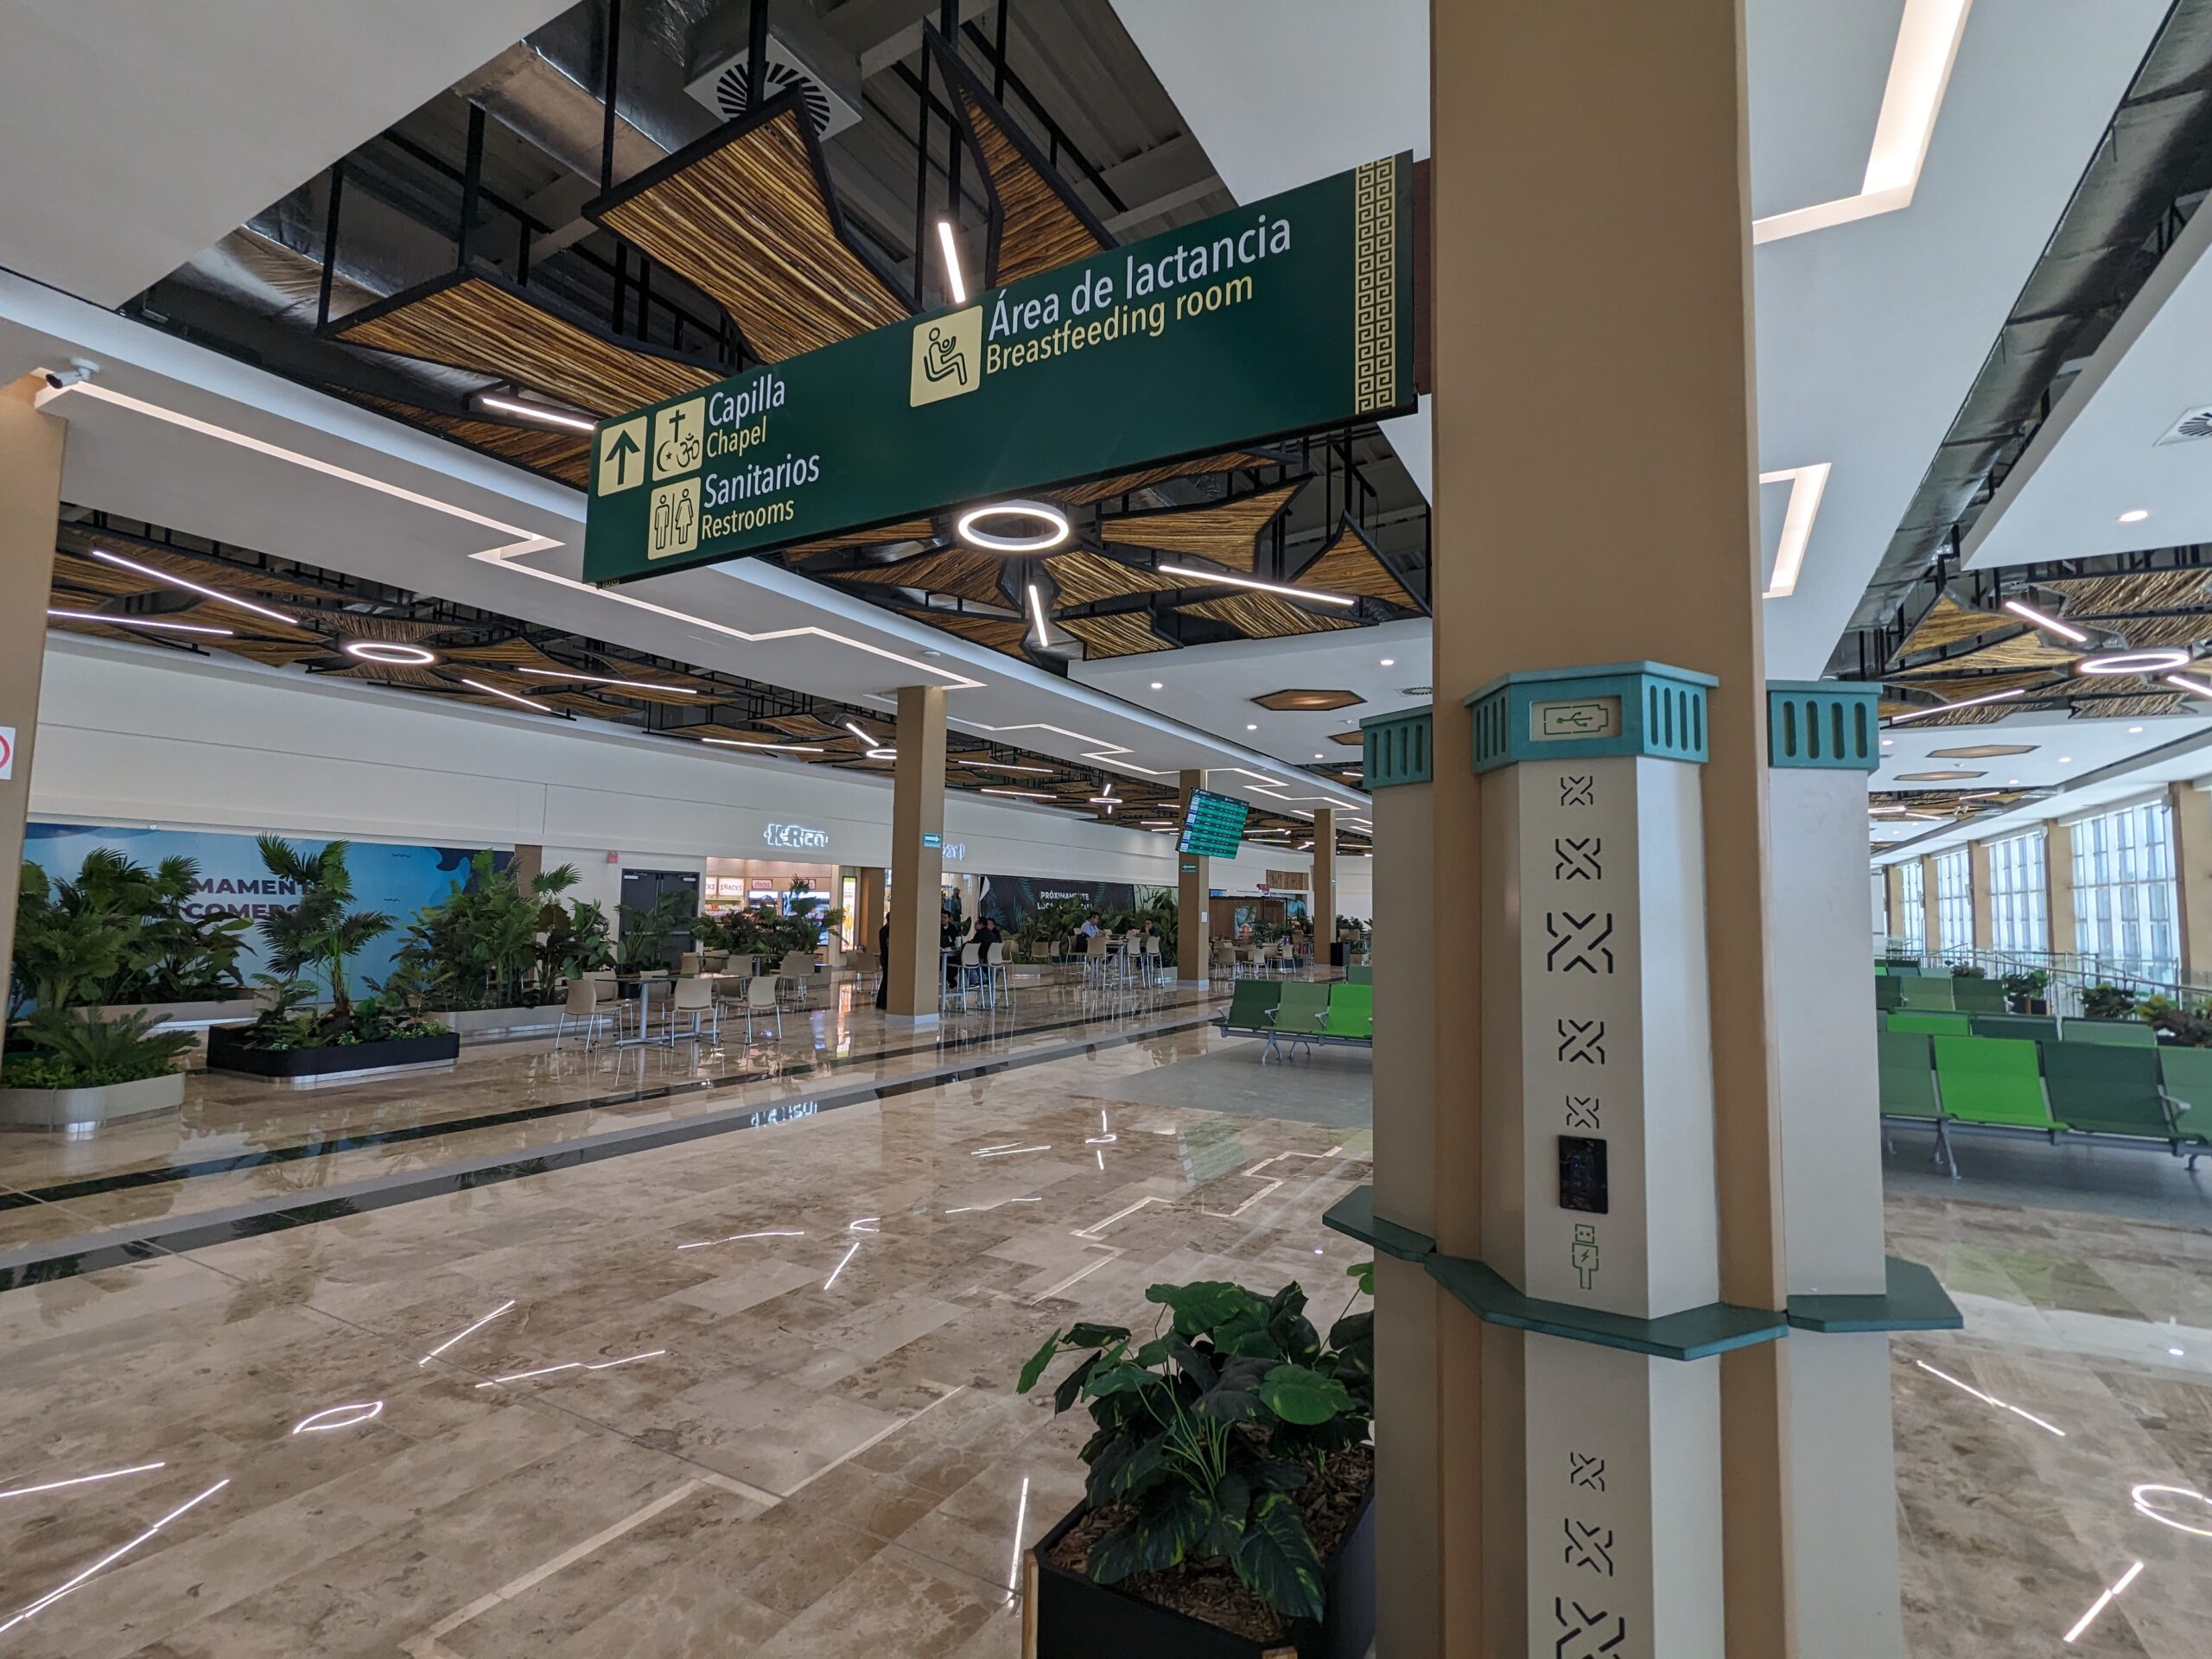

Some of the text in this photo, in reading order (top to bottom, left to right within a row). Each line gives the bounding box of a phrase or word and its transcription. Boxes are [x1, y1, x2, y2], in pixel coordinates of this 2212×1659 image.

[988, 214, 1291, 341] Área de lactancia
[987, 276, 1252, 374] Breastfeeding room
[709, 373, 785, 429] Capilla
[707, 415, 766, 457] Chapel
[703, 453, 820, 508] Sanitarios
[702, 499, 794, 540] Restrooms
[191, 878, 306, 895] MAMEN
